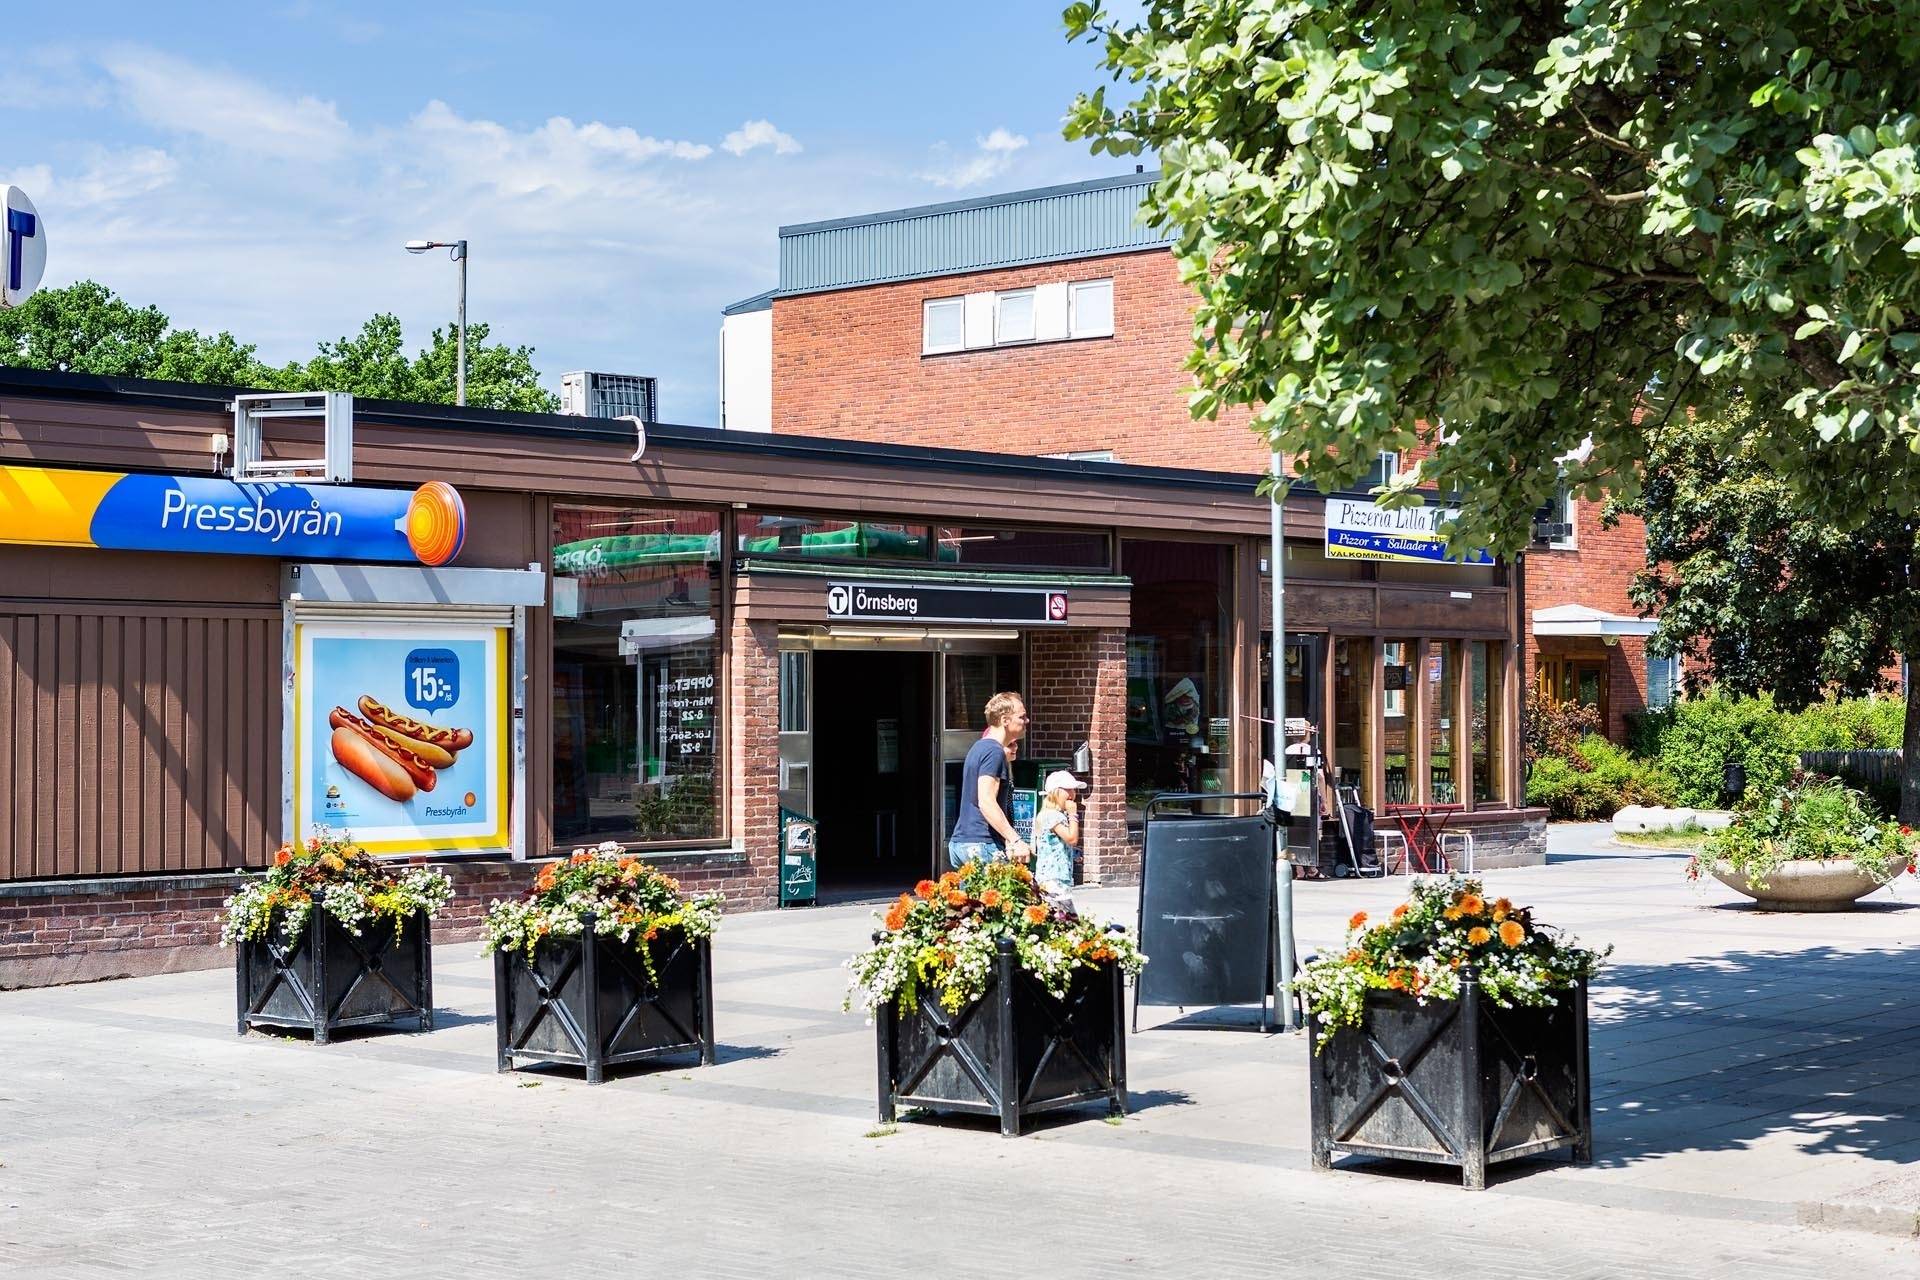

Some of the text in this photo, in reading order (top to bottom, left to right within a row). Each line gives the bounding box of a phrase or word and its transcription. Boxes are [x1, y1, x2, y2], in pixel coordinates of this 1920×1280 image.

[8, 206, 36, 291] T
[161, 489, 342, 543] Pressbyrån
[1340, 502, 1391, 528] Pizzeria
[1395, 508, 1426, 531] Lilla
[1337, 533, 1370, 547] Pizzor
[1387, 538, 1428, 551] Sallader
[832, 588, 918, 614] T Örnsberg
[425, 806, 467, 818] Pressbyrån
